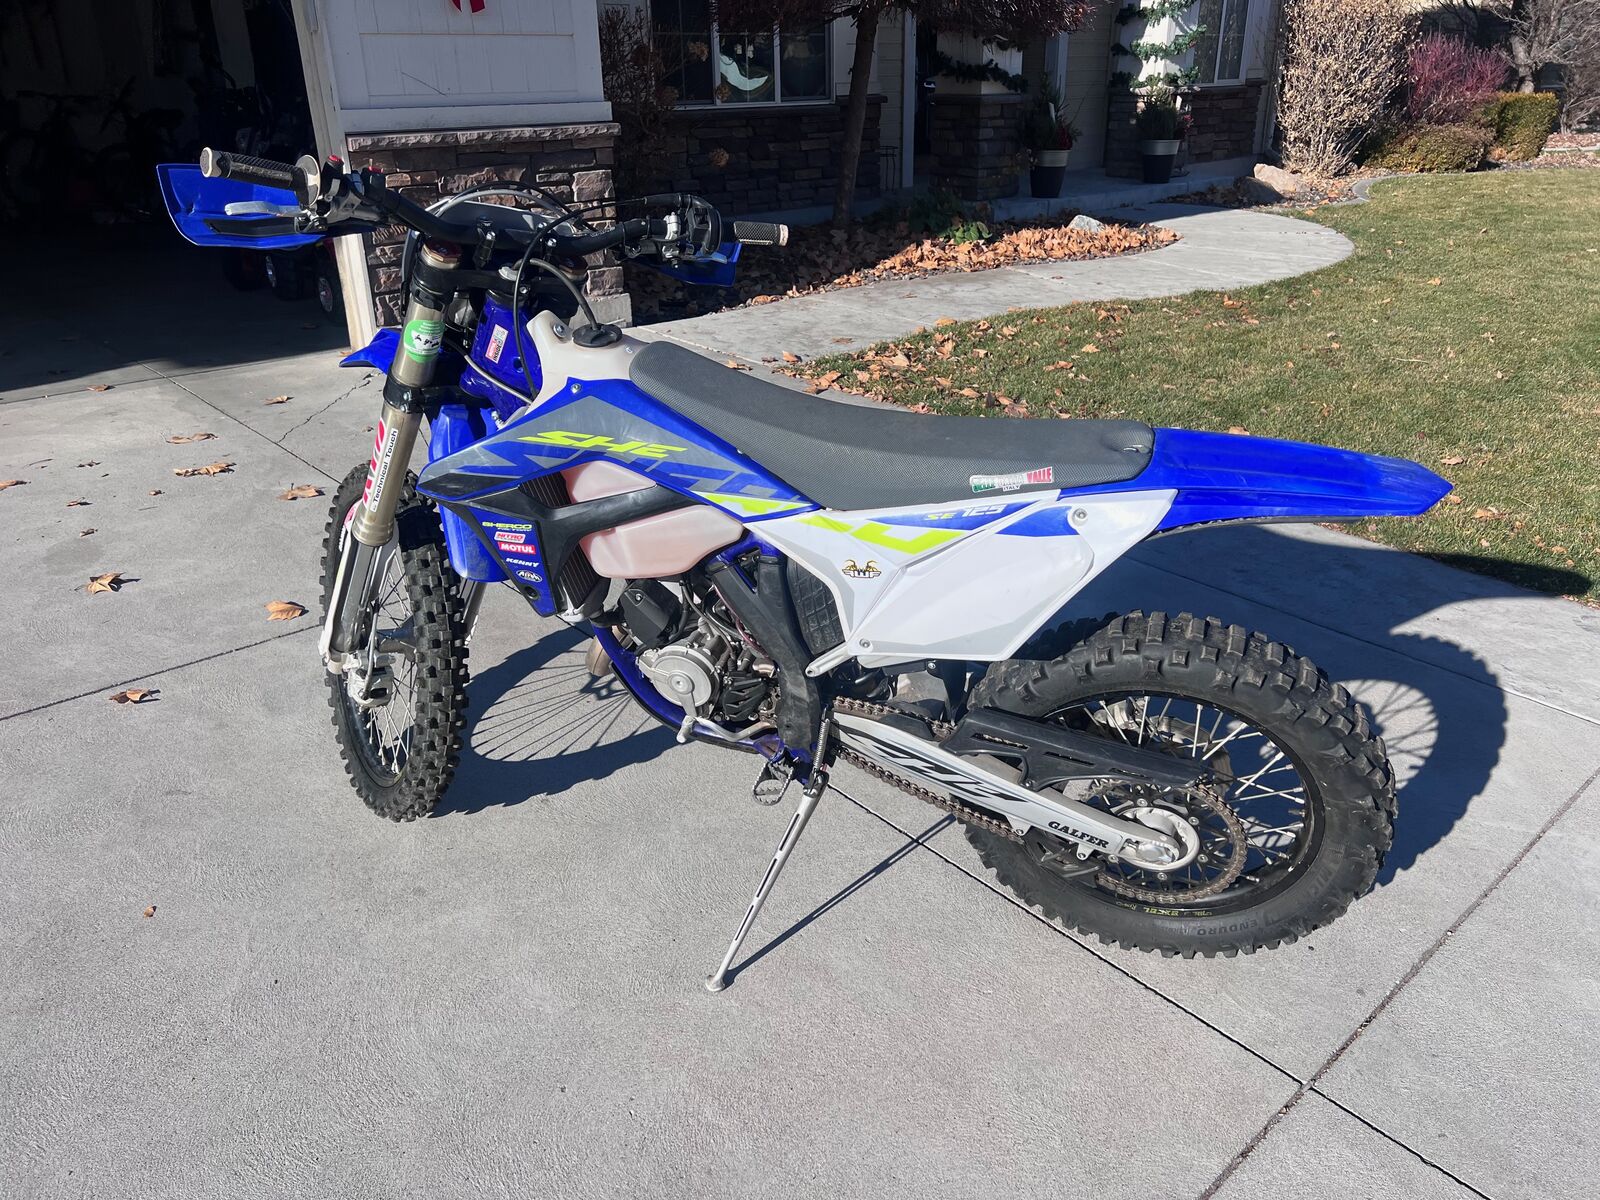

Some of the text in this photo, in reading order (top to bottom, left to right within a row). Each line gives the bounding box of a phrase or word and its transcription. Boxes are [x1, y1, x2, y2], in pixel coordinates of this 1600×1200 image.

[373, 461, 389, 504] Technical
[385, 430, 398, 459] Touch
[962, 504, 1007, 517] 125
[501, 543, 534, 553] MOTUL
[506, 557, 540, 568] KENNY
[1048, 821, 1109, 848] GALFER
[1196, 919, 1258, 936] ENDURO
